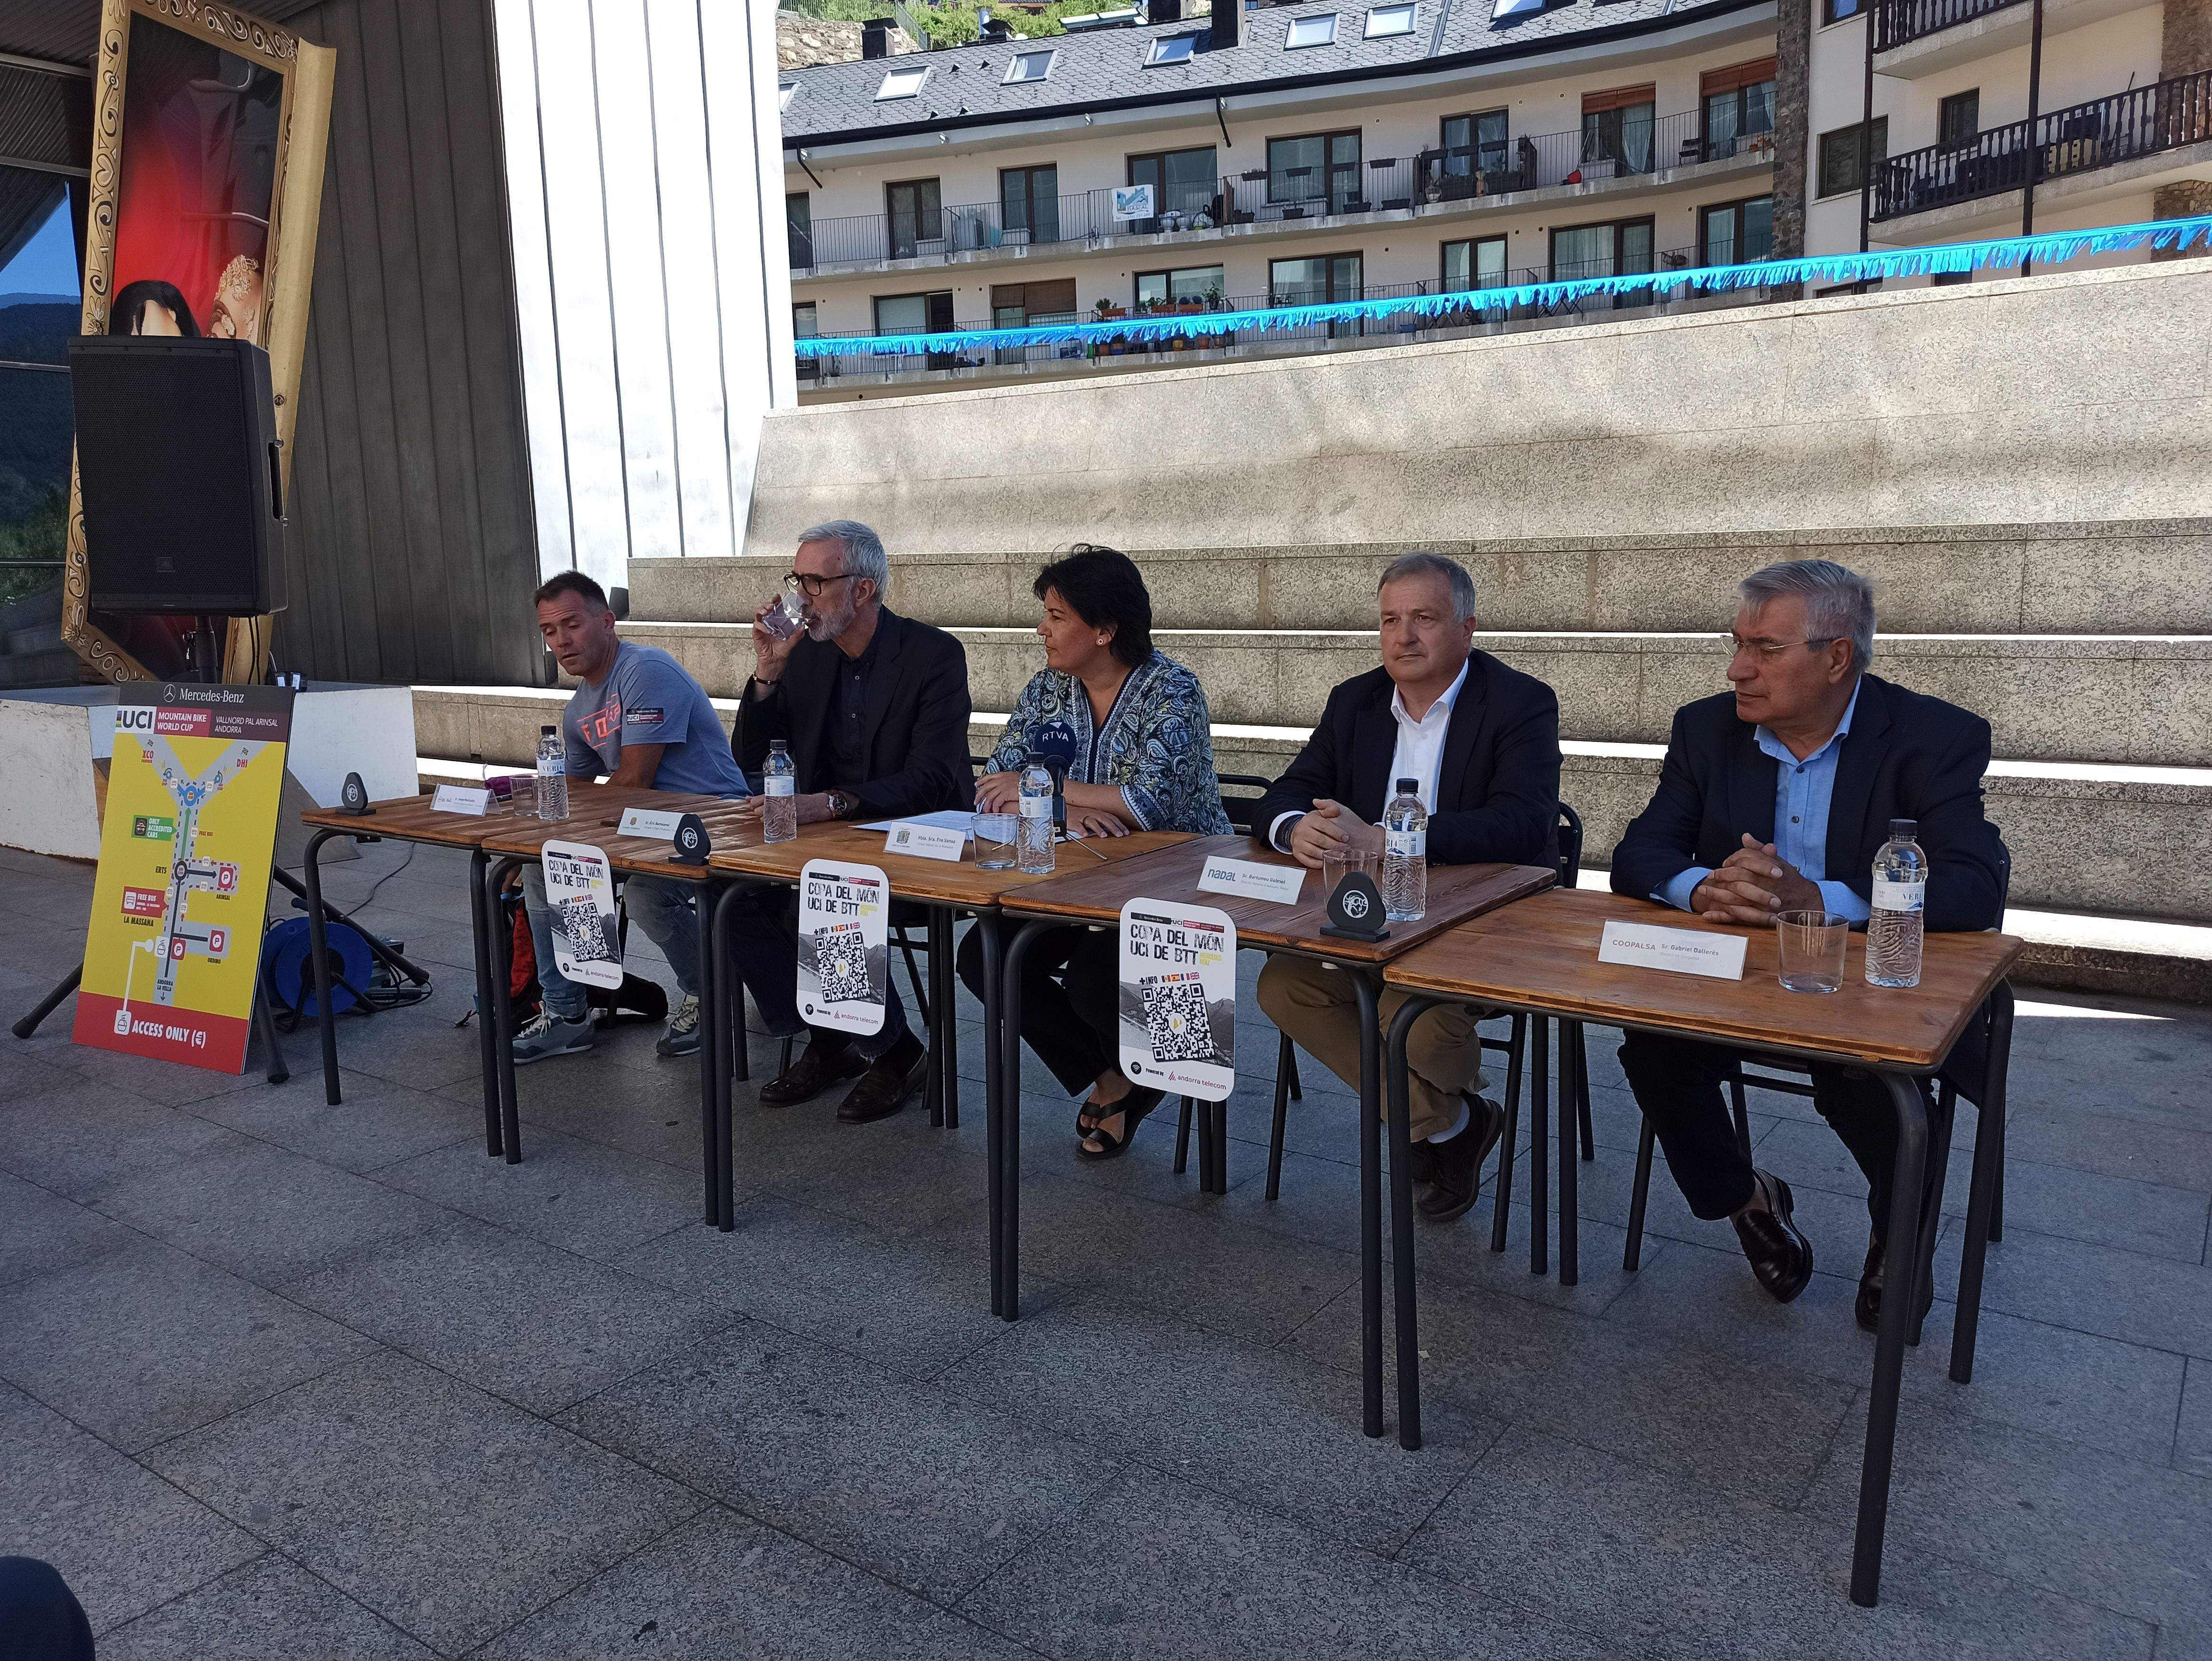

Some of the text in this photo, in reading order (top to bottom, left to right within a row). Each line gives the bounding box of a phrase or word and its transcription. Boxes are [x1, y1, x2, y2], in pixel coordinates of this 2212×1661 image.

[179, 688, 245, 703] Mercedes-Benz
[122, 710, 153, 729] UCI
[158, 712, 191, 721] MOUNTAIN
[216, 716, 244, 725] VALLNORD
[255, 719, 278, 727] ARINSAL
[157, 722, 193, 731] WORLD CUP
[215, 725, 242, 733] ANDORRA
[1042, 731, 1069, 742] RTVA
[142, 750, 154, 759] XCO
[236, 759, 248, 768] DHI
[148, 824, 172, 833] ACCREDITED
[155, 866, 167, 874] ERTS
[570, 863, 583, 875] DEL
[586, 864, 604, 879] MÓN
[550, 872, 562, 884] UCI
[564, 875, 574, 886] DE
[576, 876, 590, 889] BTT
[808, 882, 879, 904] COPA DEL MÓN
[807, 897, 860, 916] UCI DE BTT
[131, 917, 154, 927] MASSANA
[1130, 924, 1224, 952] COPA DEL MÓN
[1613, 940, 1656, 951] COOPALSA
[1130, 940, 1198, 965] UCI DE BTT
[1693, 948, 1719, 956] Dallerès
[860, 1017, 878, 1025] telecom
[132, 1020, 206, 1049] ACCESS ONLY (€)
[1178, 1075, 1227, 1090] andorra telecom
